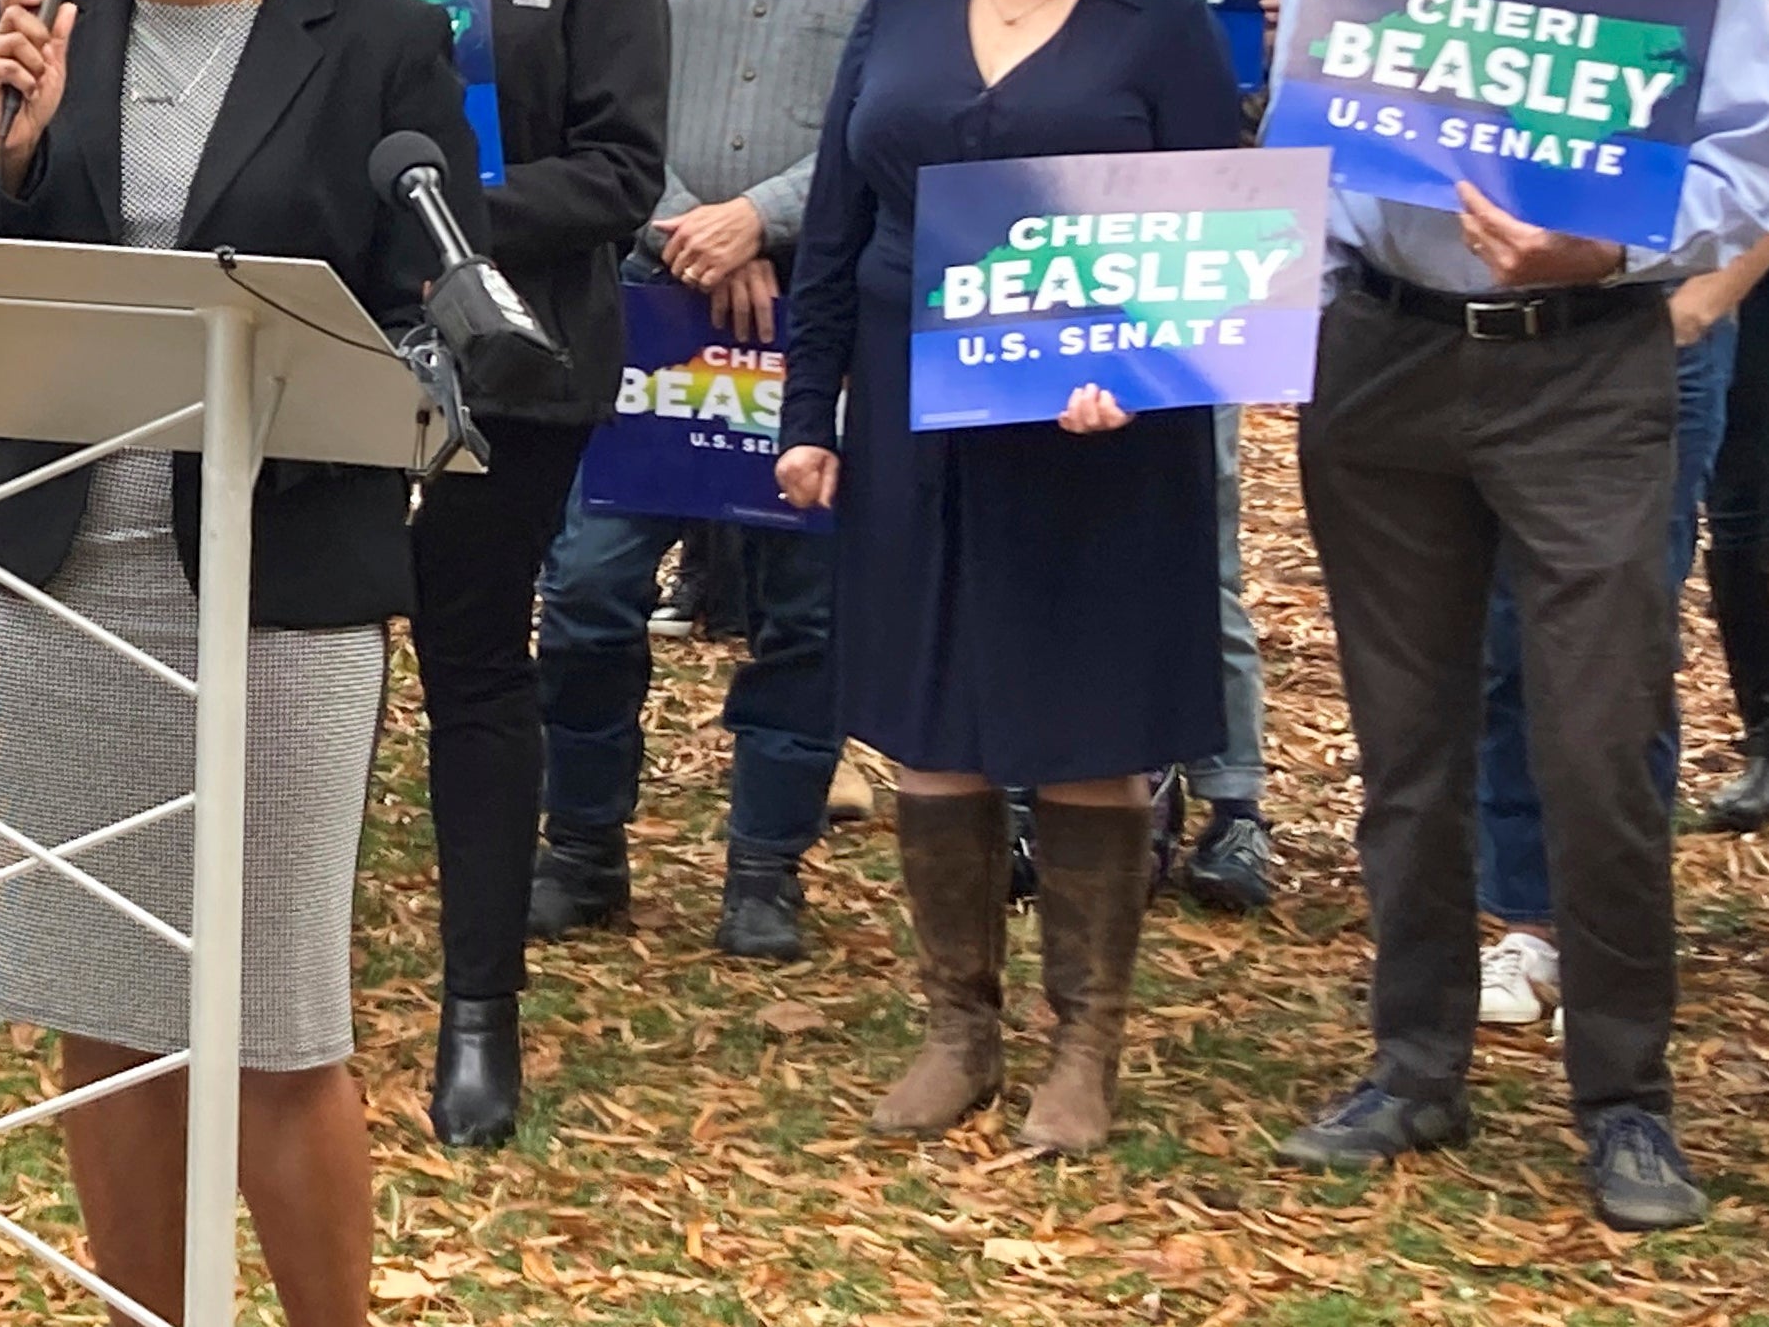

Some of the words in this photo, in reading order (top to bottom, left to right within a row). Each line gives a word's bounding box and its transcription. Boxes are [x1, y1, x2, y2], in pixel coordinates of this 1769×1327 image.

[1322, 20, 1675, 129] BEASLEY
[1326, 97, 1417, 140] U.S.
[1437, 117, 1628, 176] SENATE
[1009, 211, 1203, 251] CHERI
[943, 248, 1290, 320] BEASLEY
[702, 345, 785, 372] CHE
[958, 332, 1041, 366] U.S.
[1059, 318, 1246, 356] SENATE
[615, 366, 784, 428] BEAS
[690, 432, 733, 450] U.S.
